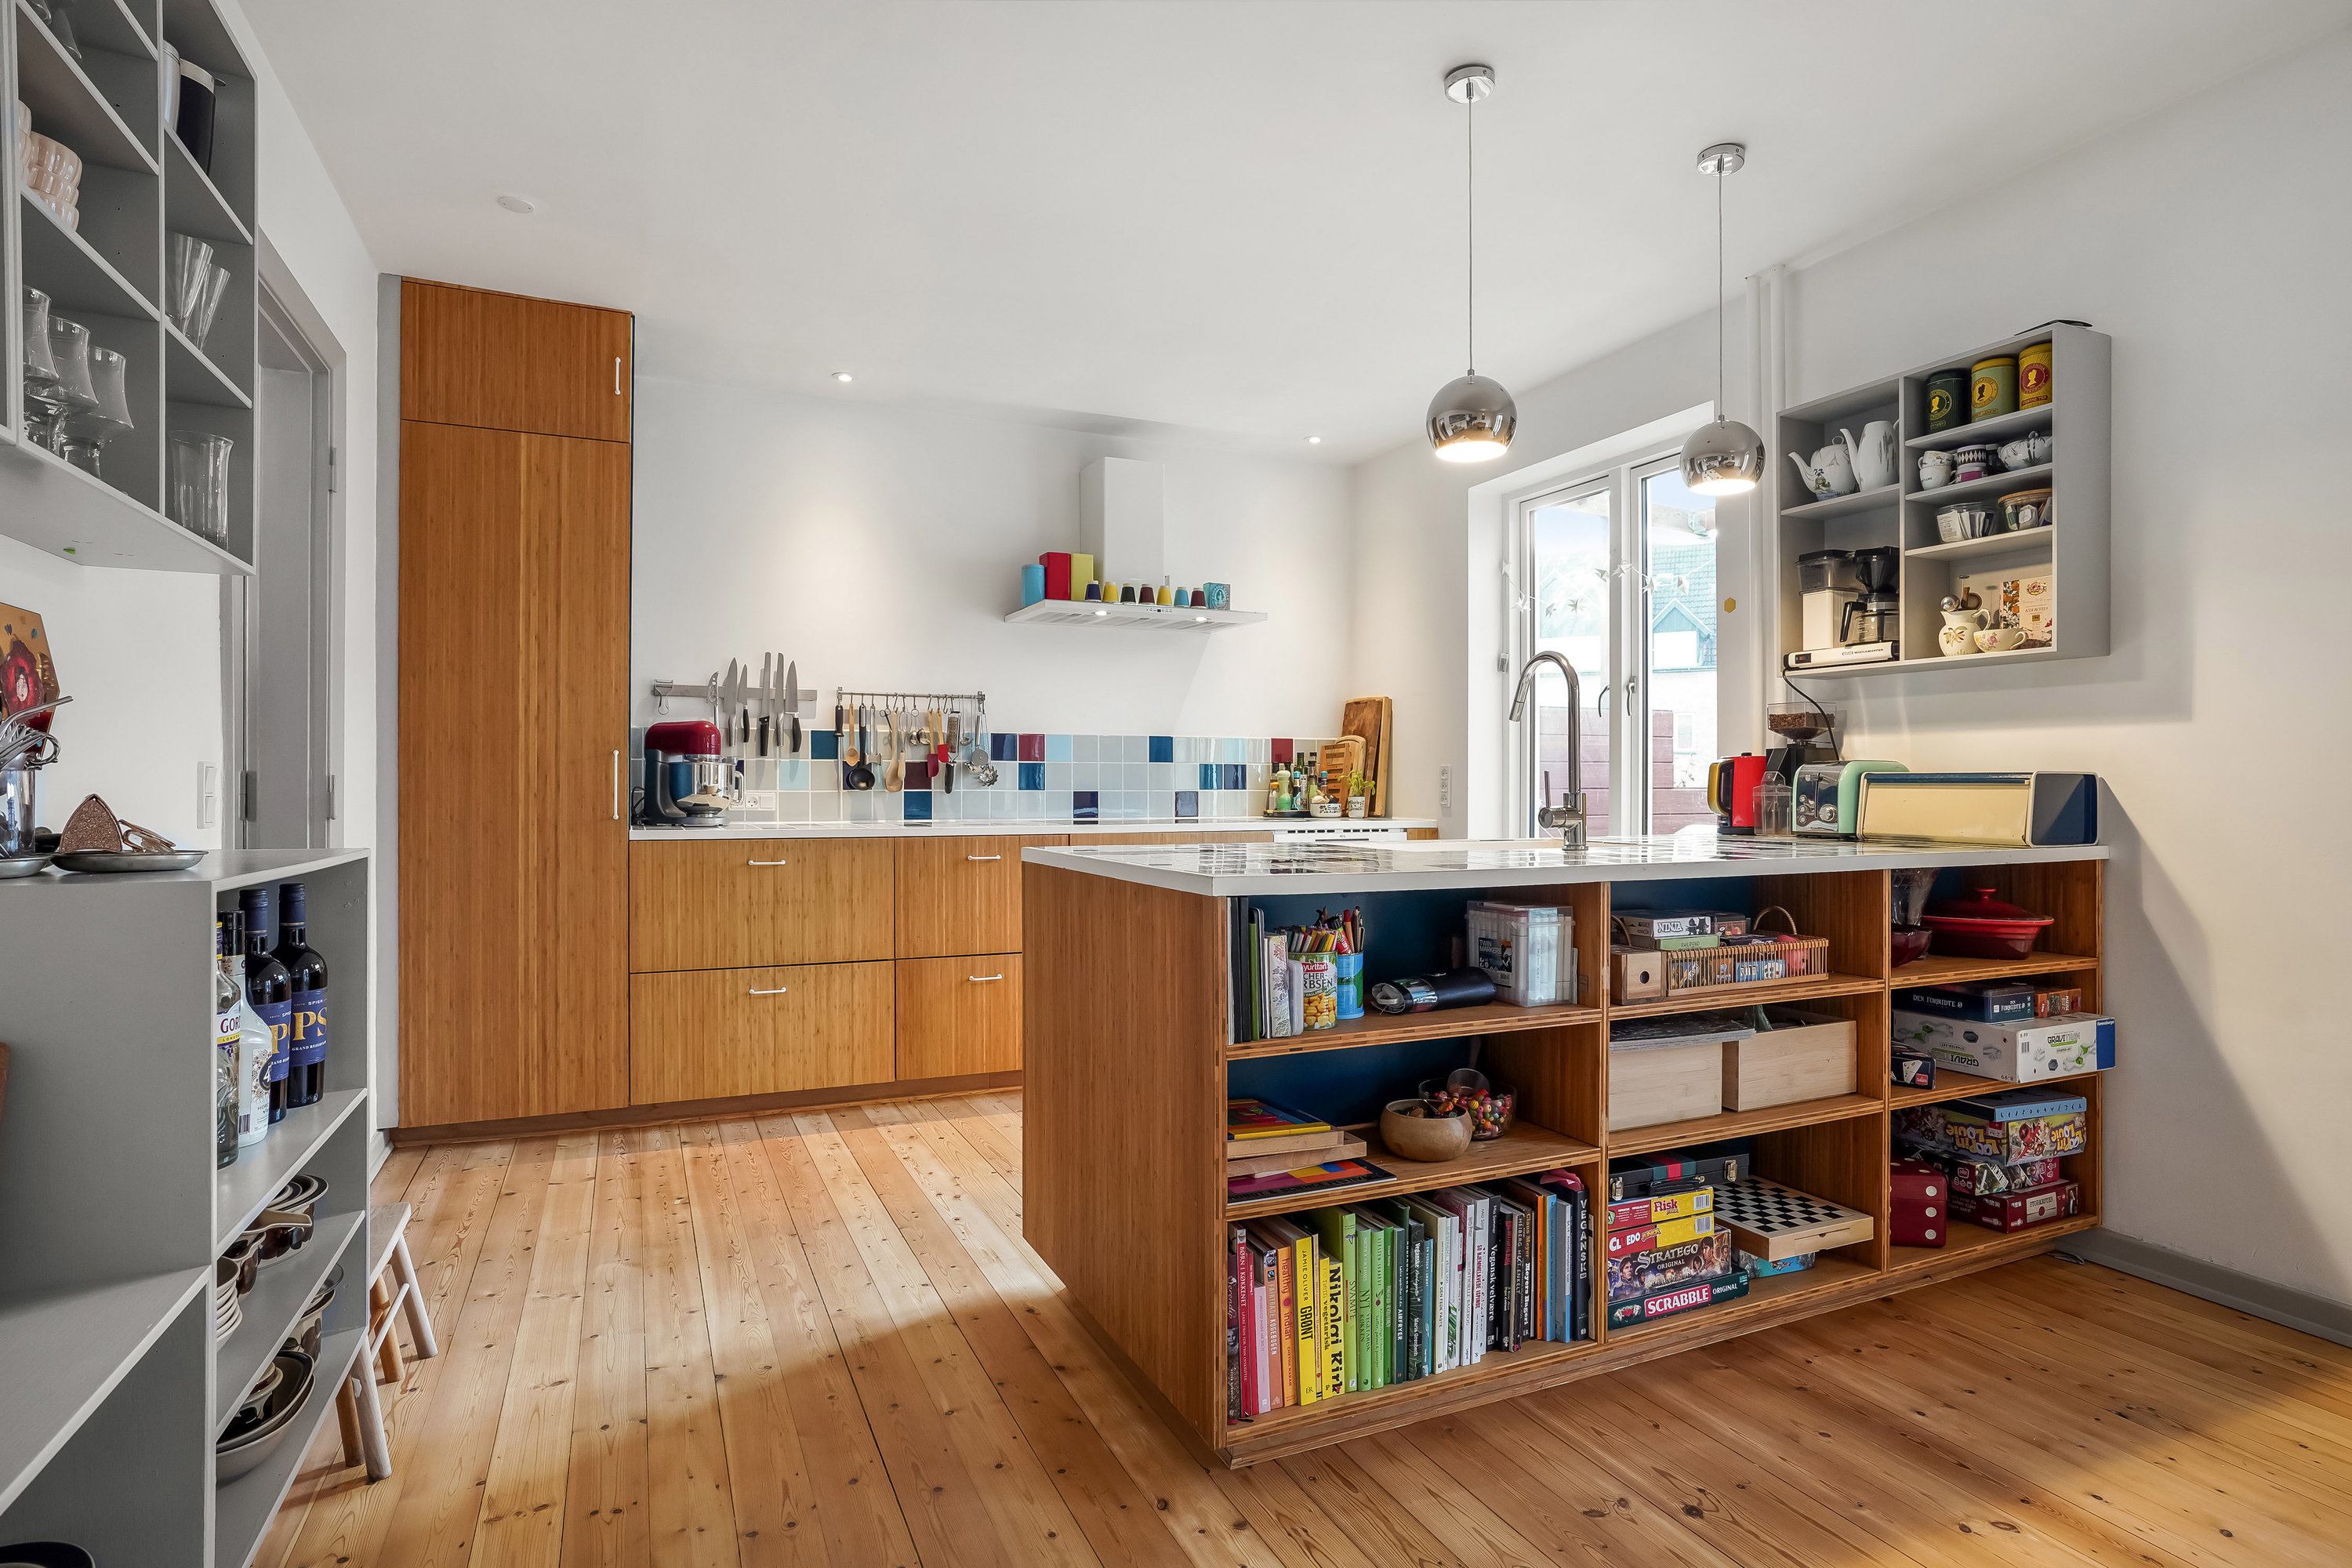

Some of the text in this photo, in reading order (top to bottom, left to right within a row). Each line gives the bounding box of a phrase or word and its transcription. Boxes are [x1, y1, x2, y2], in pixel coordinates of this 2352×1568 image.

[1657, 921, 1683, 933] NINJA
[1479, 946, 1502, 955] MARKERS
[1303, 978, 1333, 989] RBSEN
[1654, 1199, 1678, 1212] Risk
[1609, 1232, 1641, 1252] CLUEDO
[1637, 1244, 1699, 1267] STRATEGO
[1657, 1258, 1686, 1270] ORIGINAL
[1282, 1258, 1293, 1340] healthy indian
[1359, 1290, 1370, 1308] NYT
[1647, 1283, 1738, 1314] SCRABBLE ORIGINAL
[1301, 1305, 1313, 1340] GRØNT
[1331, 1351, 1342, 1394] Kirk
